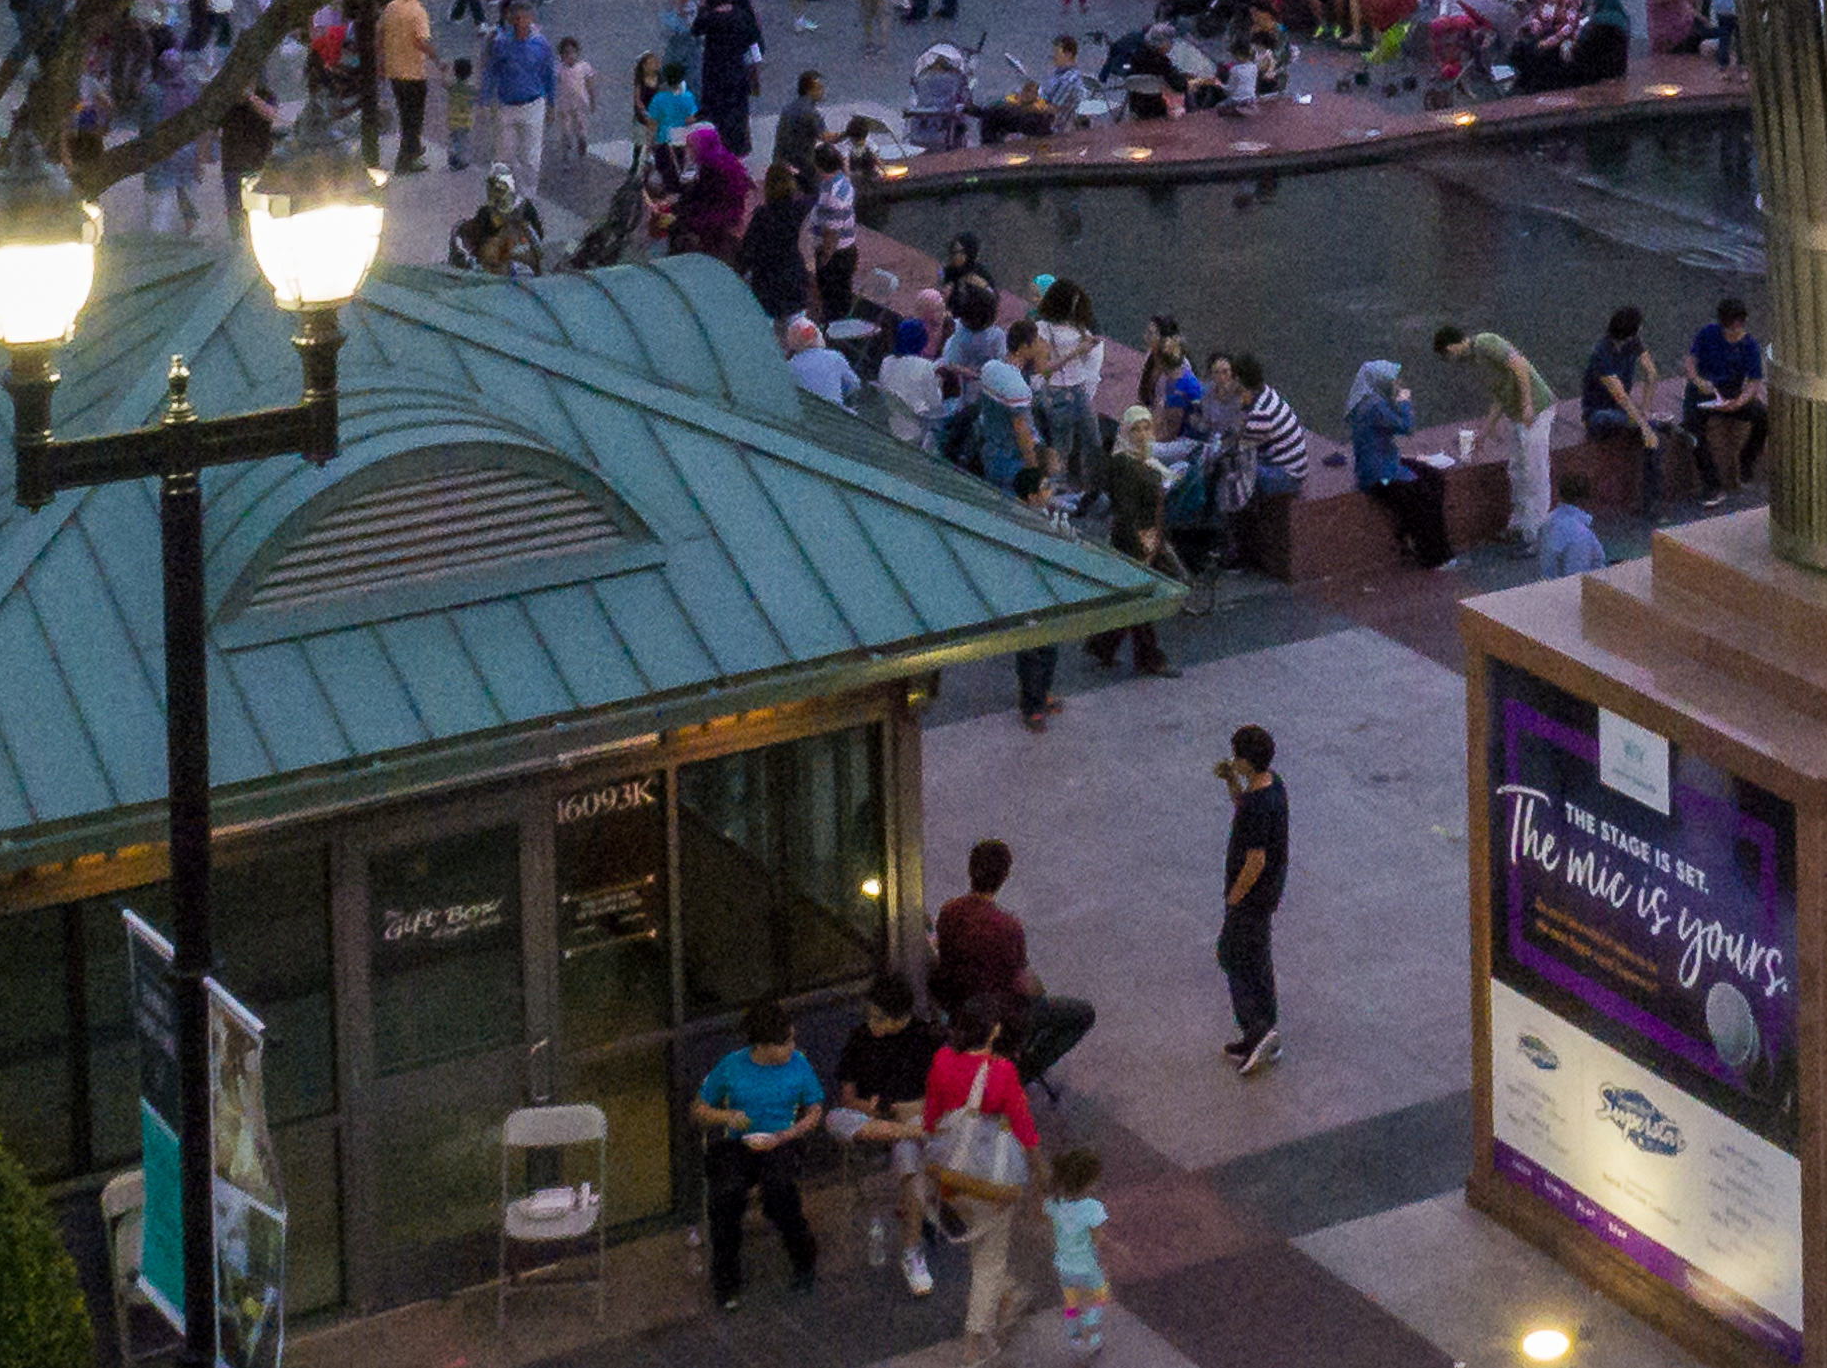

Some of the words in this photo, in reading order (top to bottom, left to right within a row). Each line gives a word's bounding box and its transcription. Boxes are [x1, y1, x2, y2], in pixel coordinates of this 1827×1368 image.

[556, 777, 656, 824] 16093K
[1495, 783, 1561, 872] The
[1566, 847, 1633, 909] mic
[1636, 874, 1672, 937] is
[1677, 906, 1789, 998] yours.
[1564, 801, 1596, 835] THE
[1600, 819, 1651, 863] STAGE
[1654, 847, 1671, 874] IS
[1675, 858, 1710, 895] SET.
